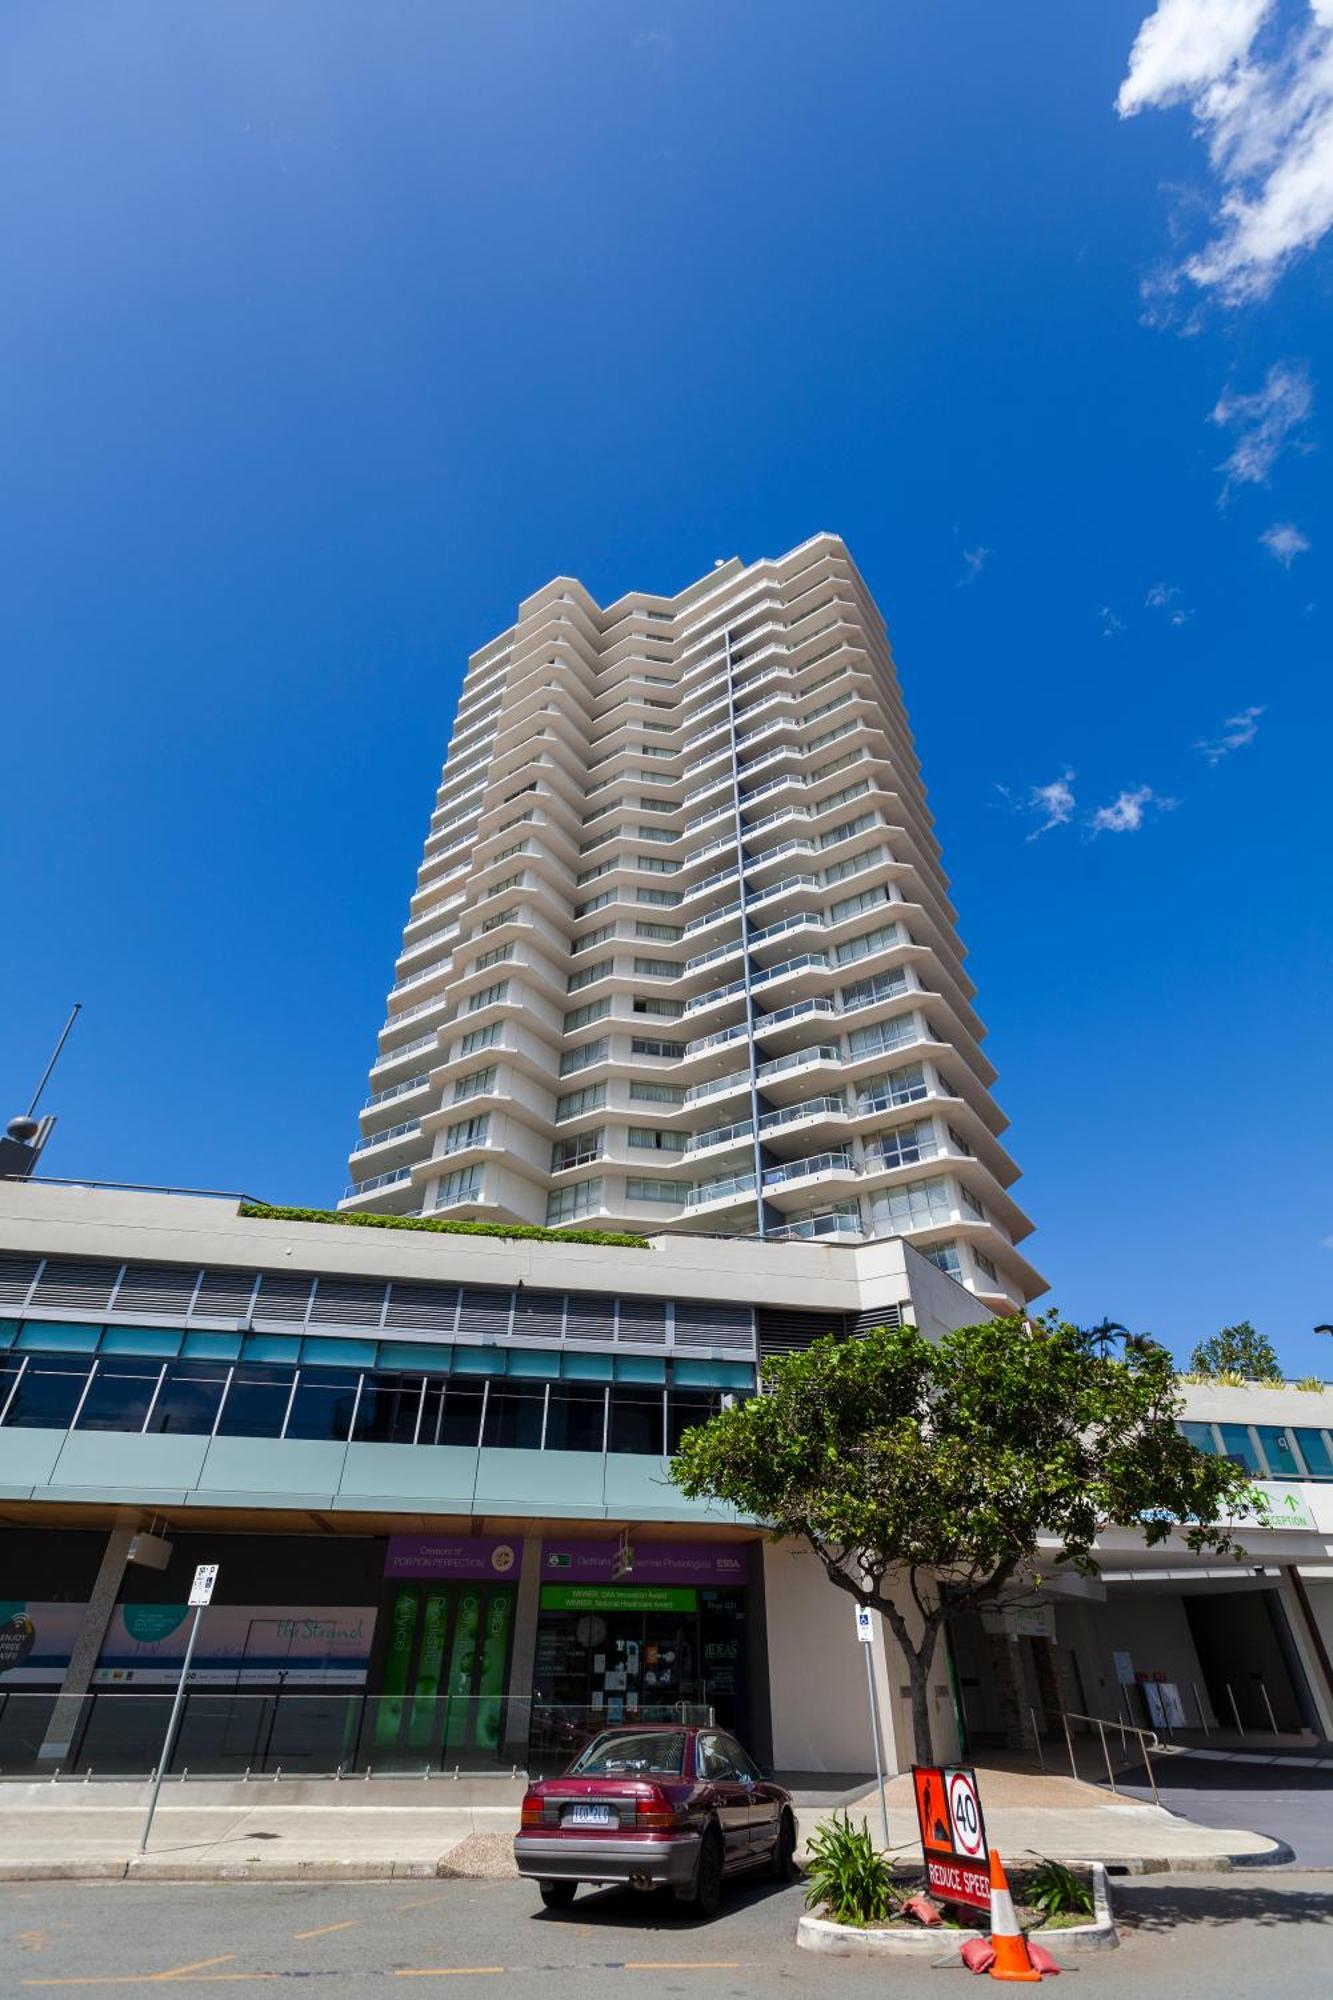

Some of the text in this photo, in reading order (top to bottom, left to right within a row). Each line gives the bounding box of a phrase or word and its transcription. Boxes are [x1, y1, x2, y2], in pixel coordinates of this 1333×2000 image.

[433, 1558, 485, 1568] PERFECTION
[956, 1793, 977, 1834] 40
[929, 1863, 962, 1891] REDUCE
